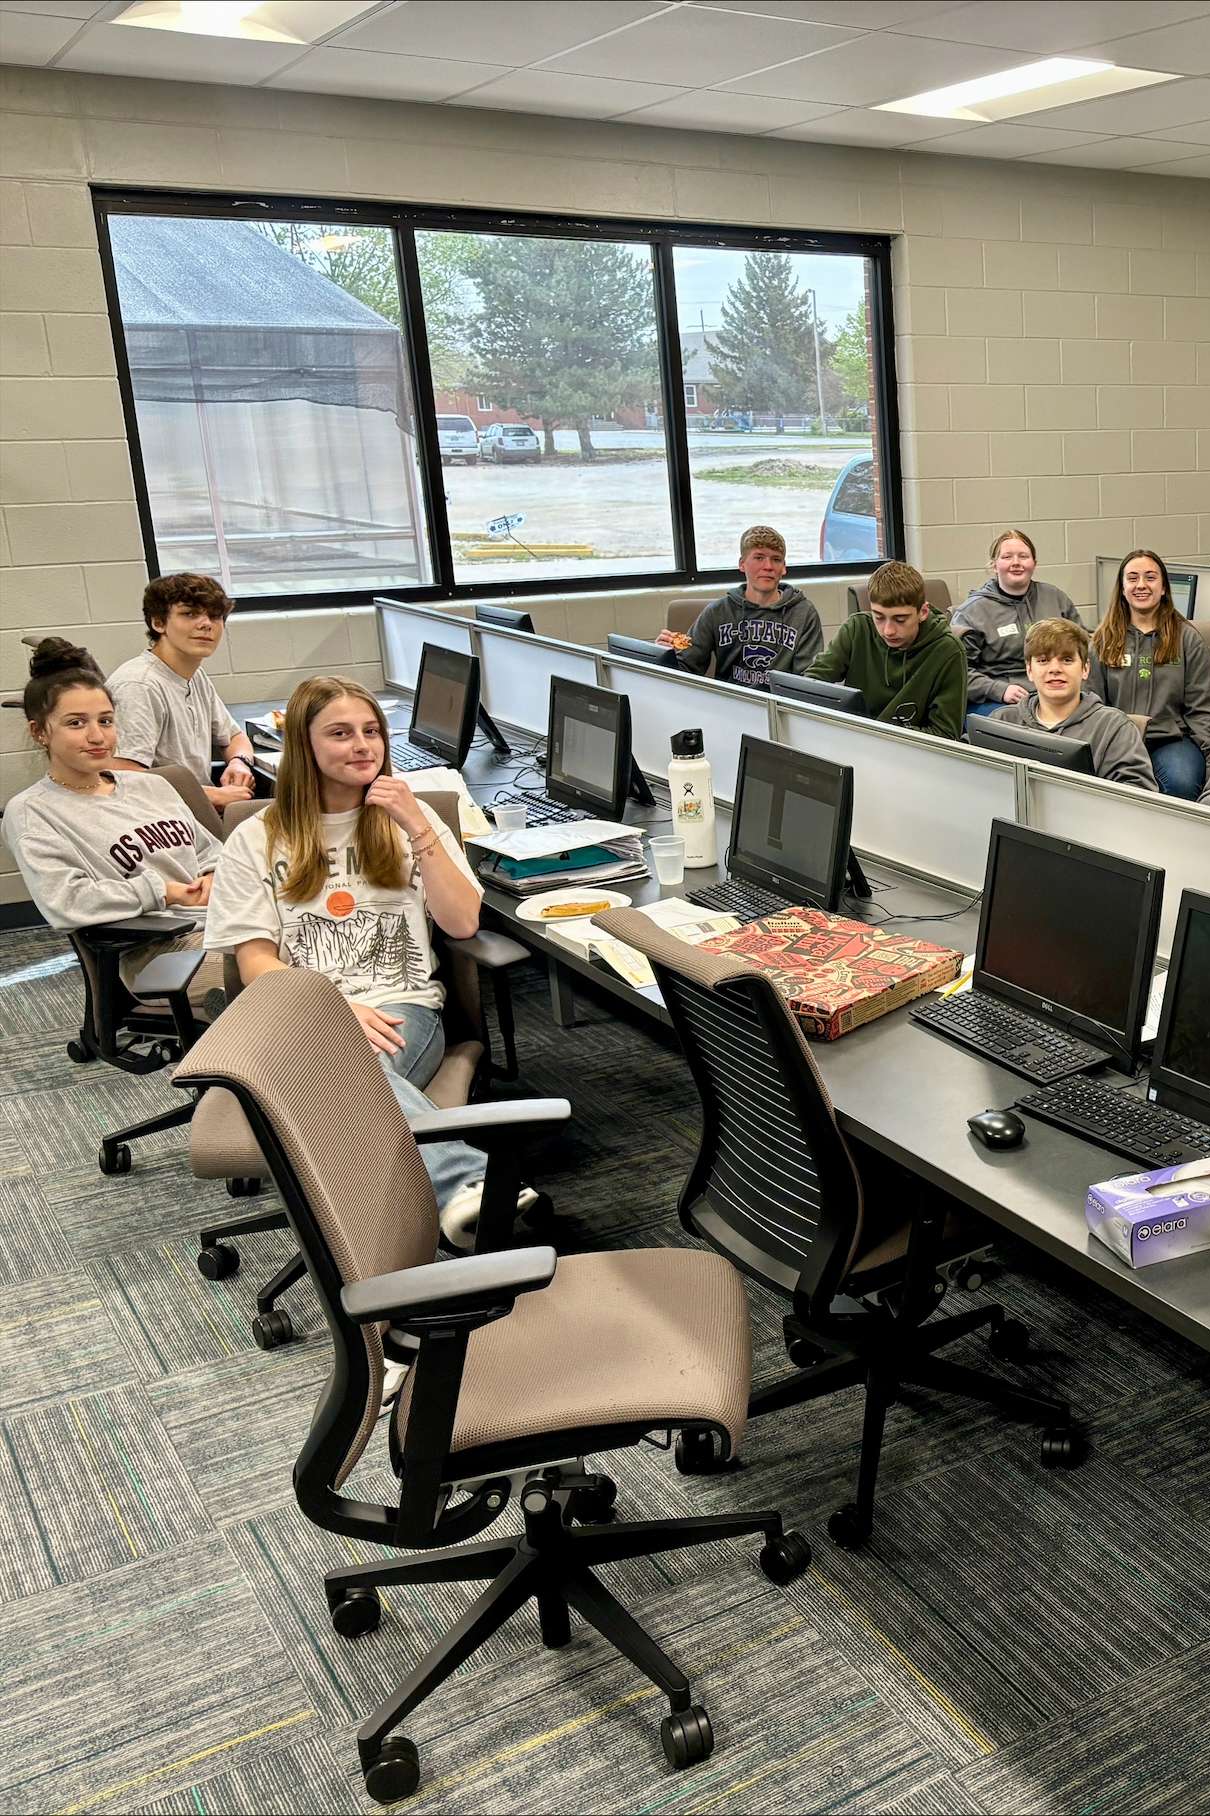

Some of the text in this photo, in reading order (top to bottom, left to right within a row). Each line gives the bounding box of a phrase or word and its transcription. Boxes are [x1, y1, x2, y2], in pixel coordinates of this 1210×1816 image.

[718, 619, 798, 651] K-STATE
[733, 665, 770, 684] WILDC
[109, 834, 143, 880] OS
[1151, 1216, 1189, 1236] elara
